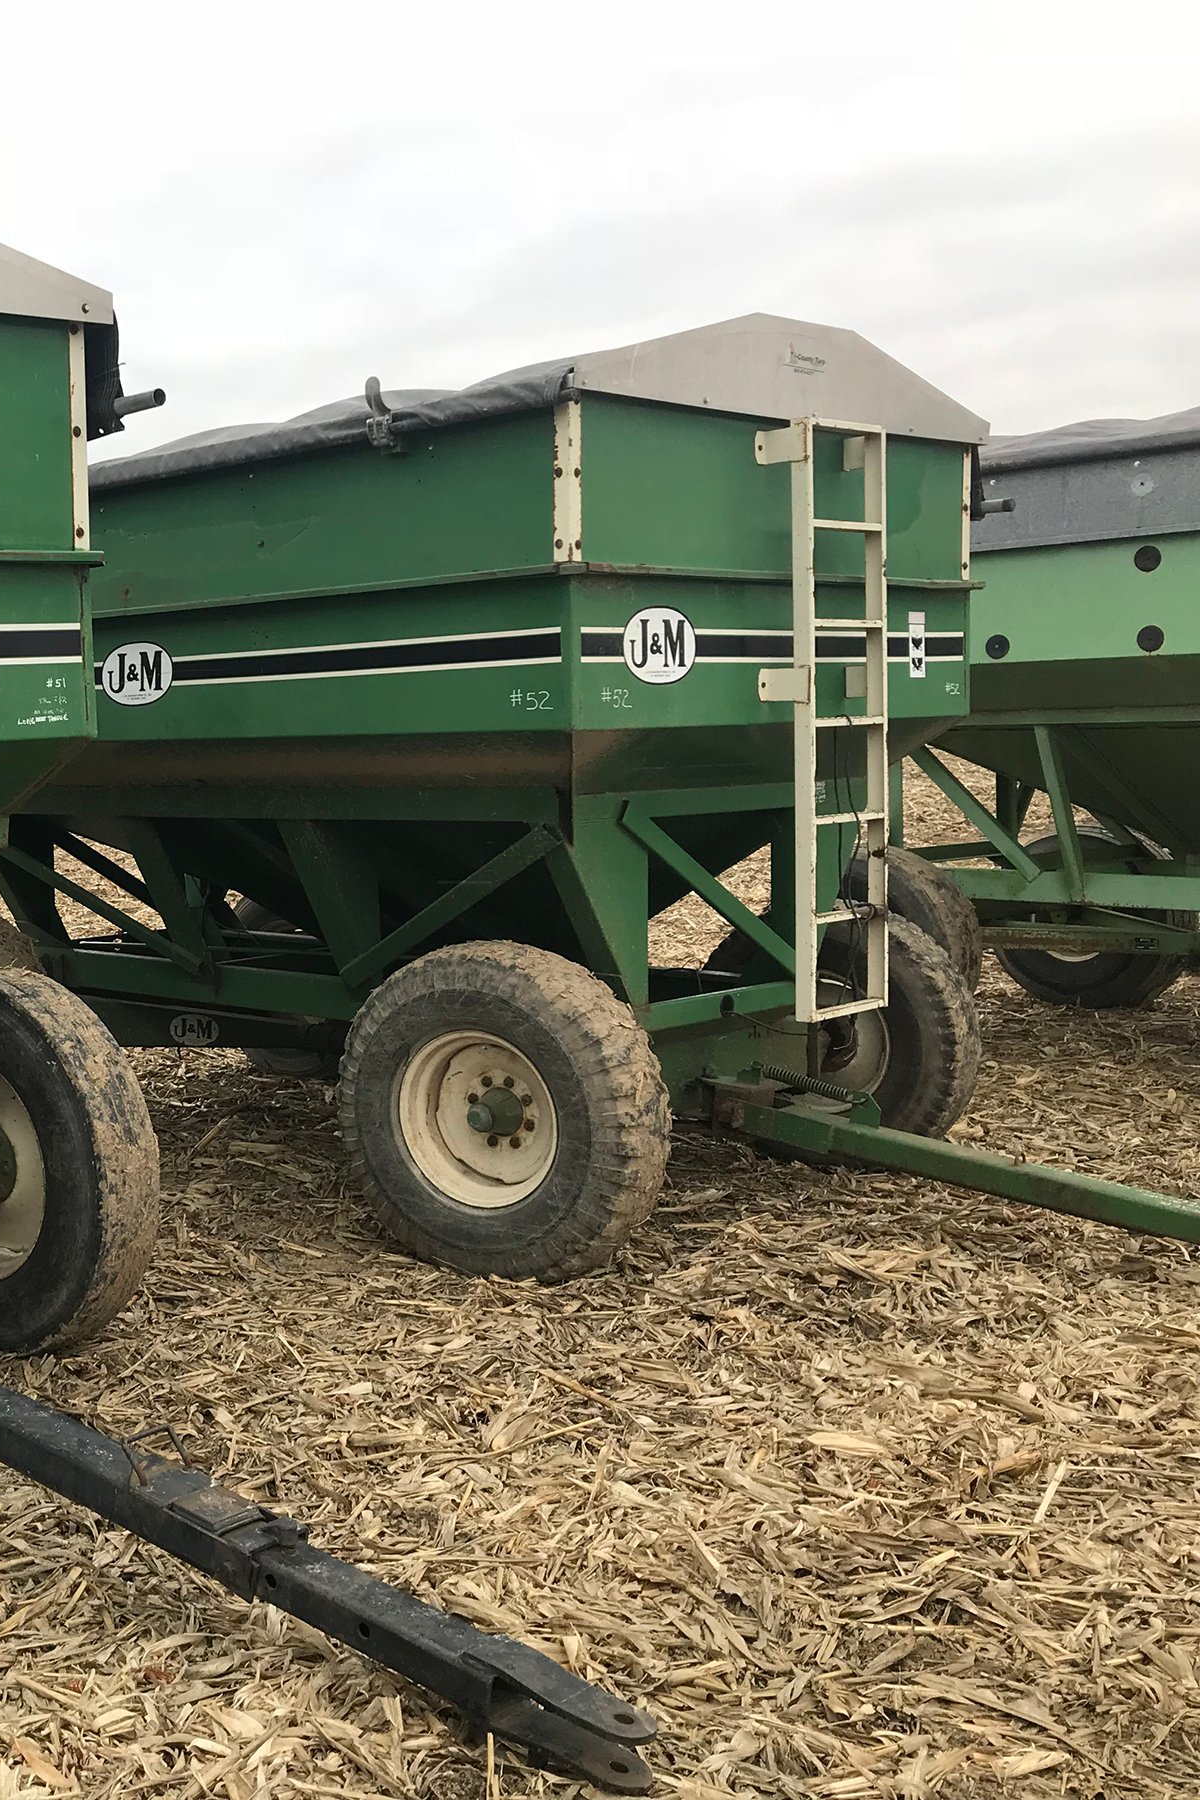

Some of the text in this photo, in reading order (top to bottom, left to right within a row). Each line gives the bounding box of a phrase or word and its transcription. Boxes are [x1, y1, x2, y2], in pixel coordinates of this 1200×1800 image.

[629, 619, 687, 668] J&M
[46, 677, 66, 688] #51
[107, 650, 163, 694] J&M
[601, 687, 632, 708] #52
[945, 682, 960, 695] #52
[509, 689, 554, 710] #52
[173, 1018, 213, 1039] J&M
